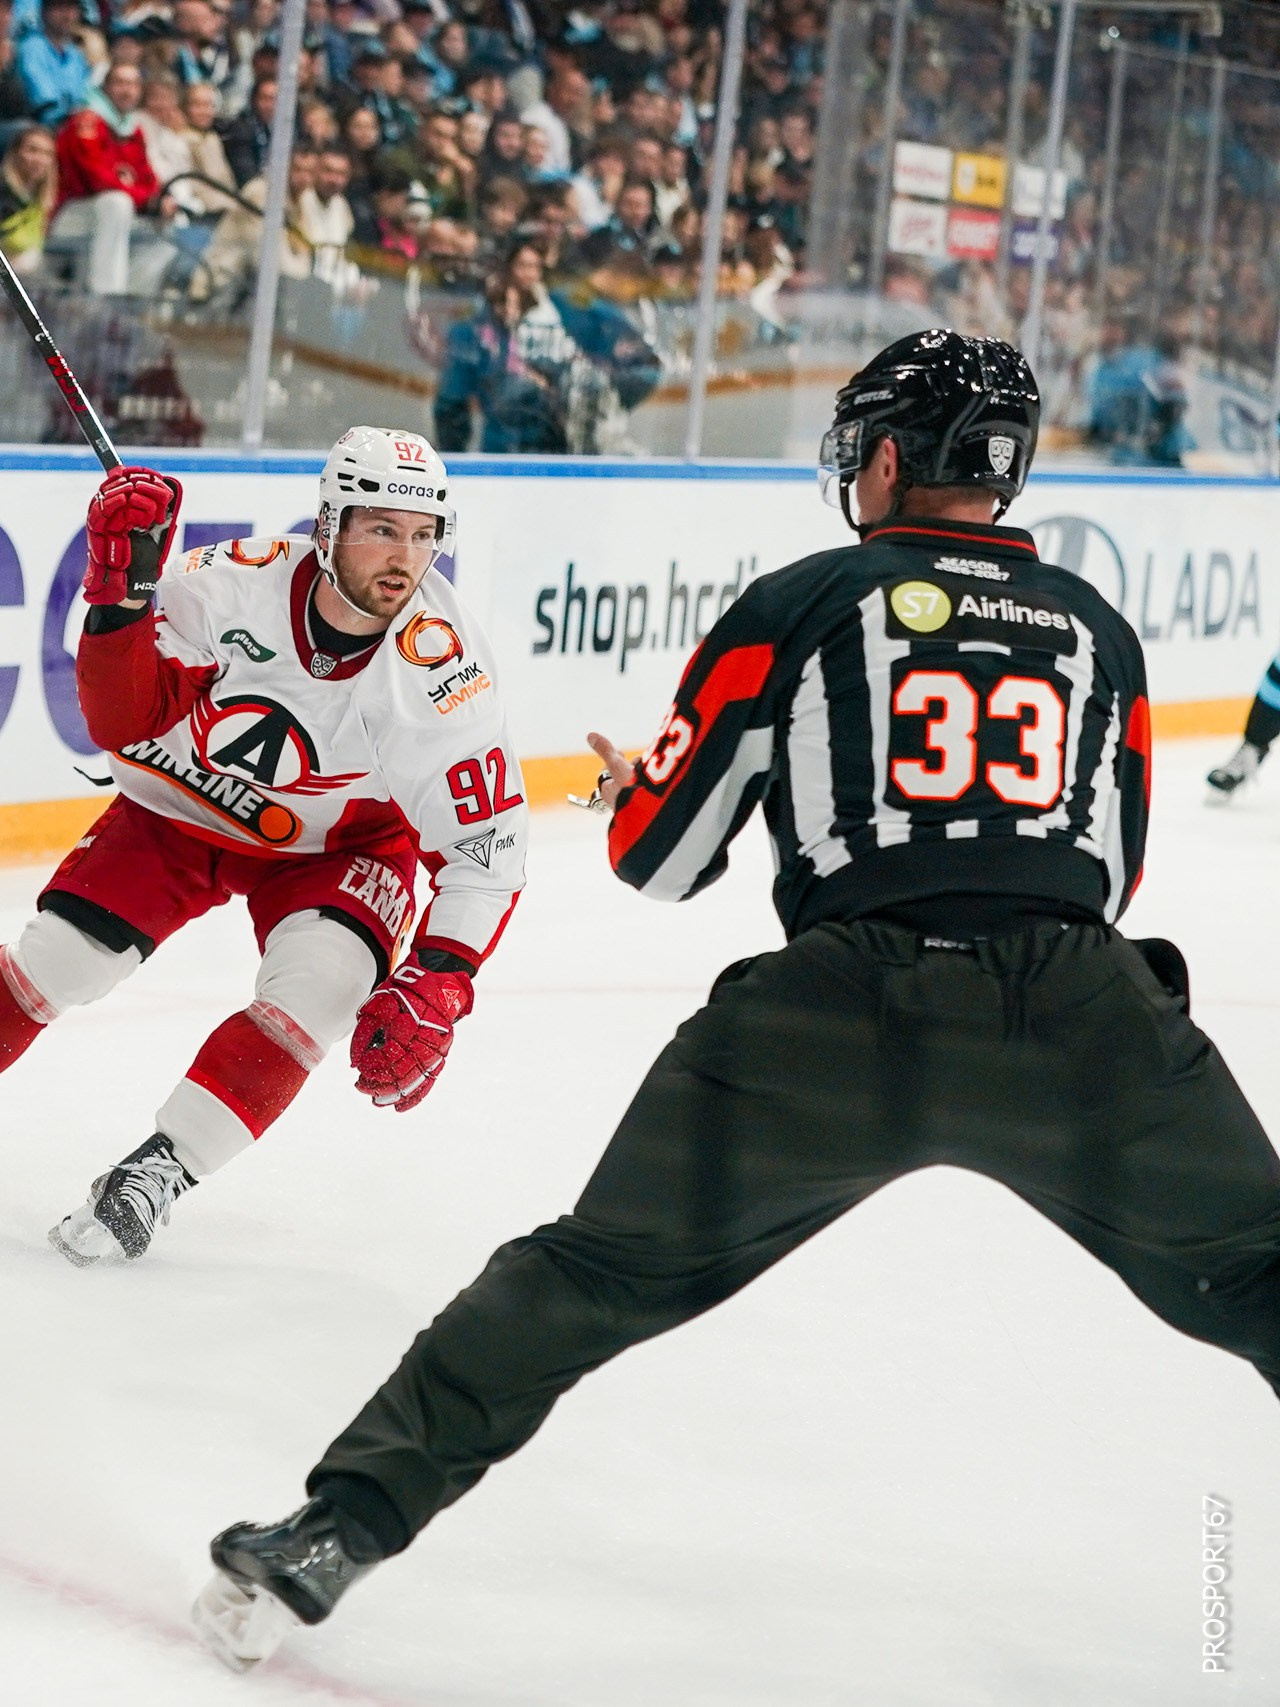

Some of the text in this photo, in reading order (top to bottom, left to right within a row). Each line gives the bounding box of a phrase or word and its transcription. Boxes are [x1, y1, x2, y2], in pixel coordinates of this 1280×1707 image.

[394, 441, 427, 463] 92
[387, 482, 434, 498] согаз
[901, 591, 1070, 631] S7 Airlines
[1138, 552, 1262, 640] LADA
[435, 674, 492, 715] UMMC
[890, 669, 1066, 810] 33
[446, 747, 524, 825] 92
